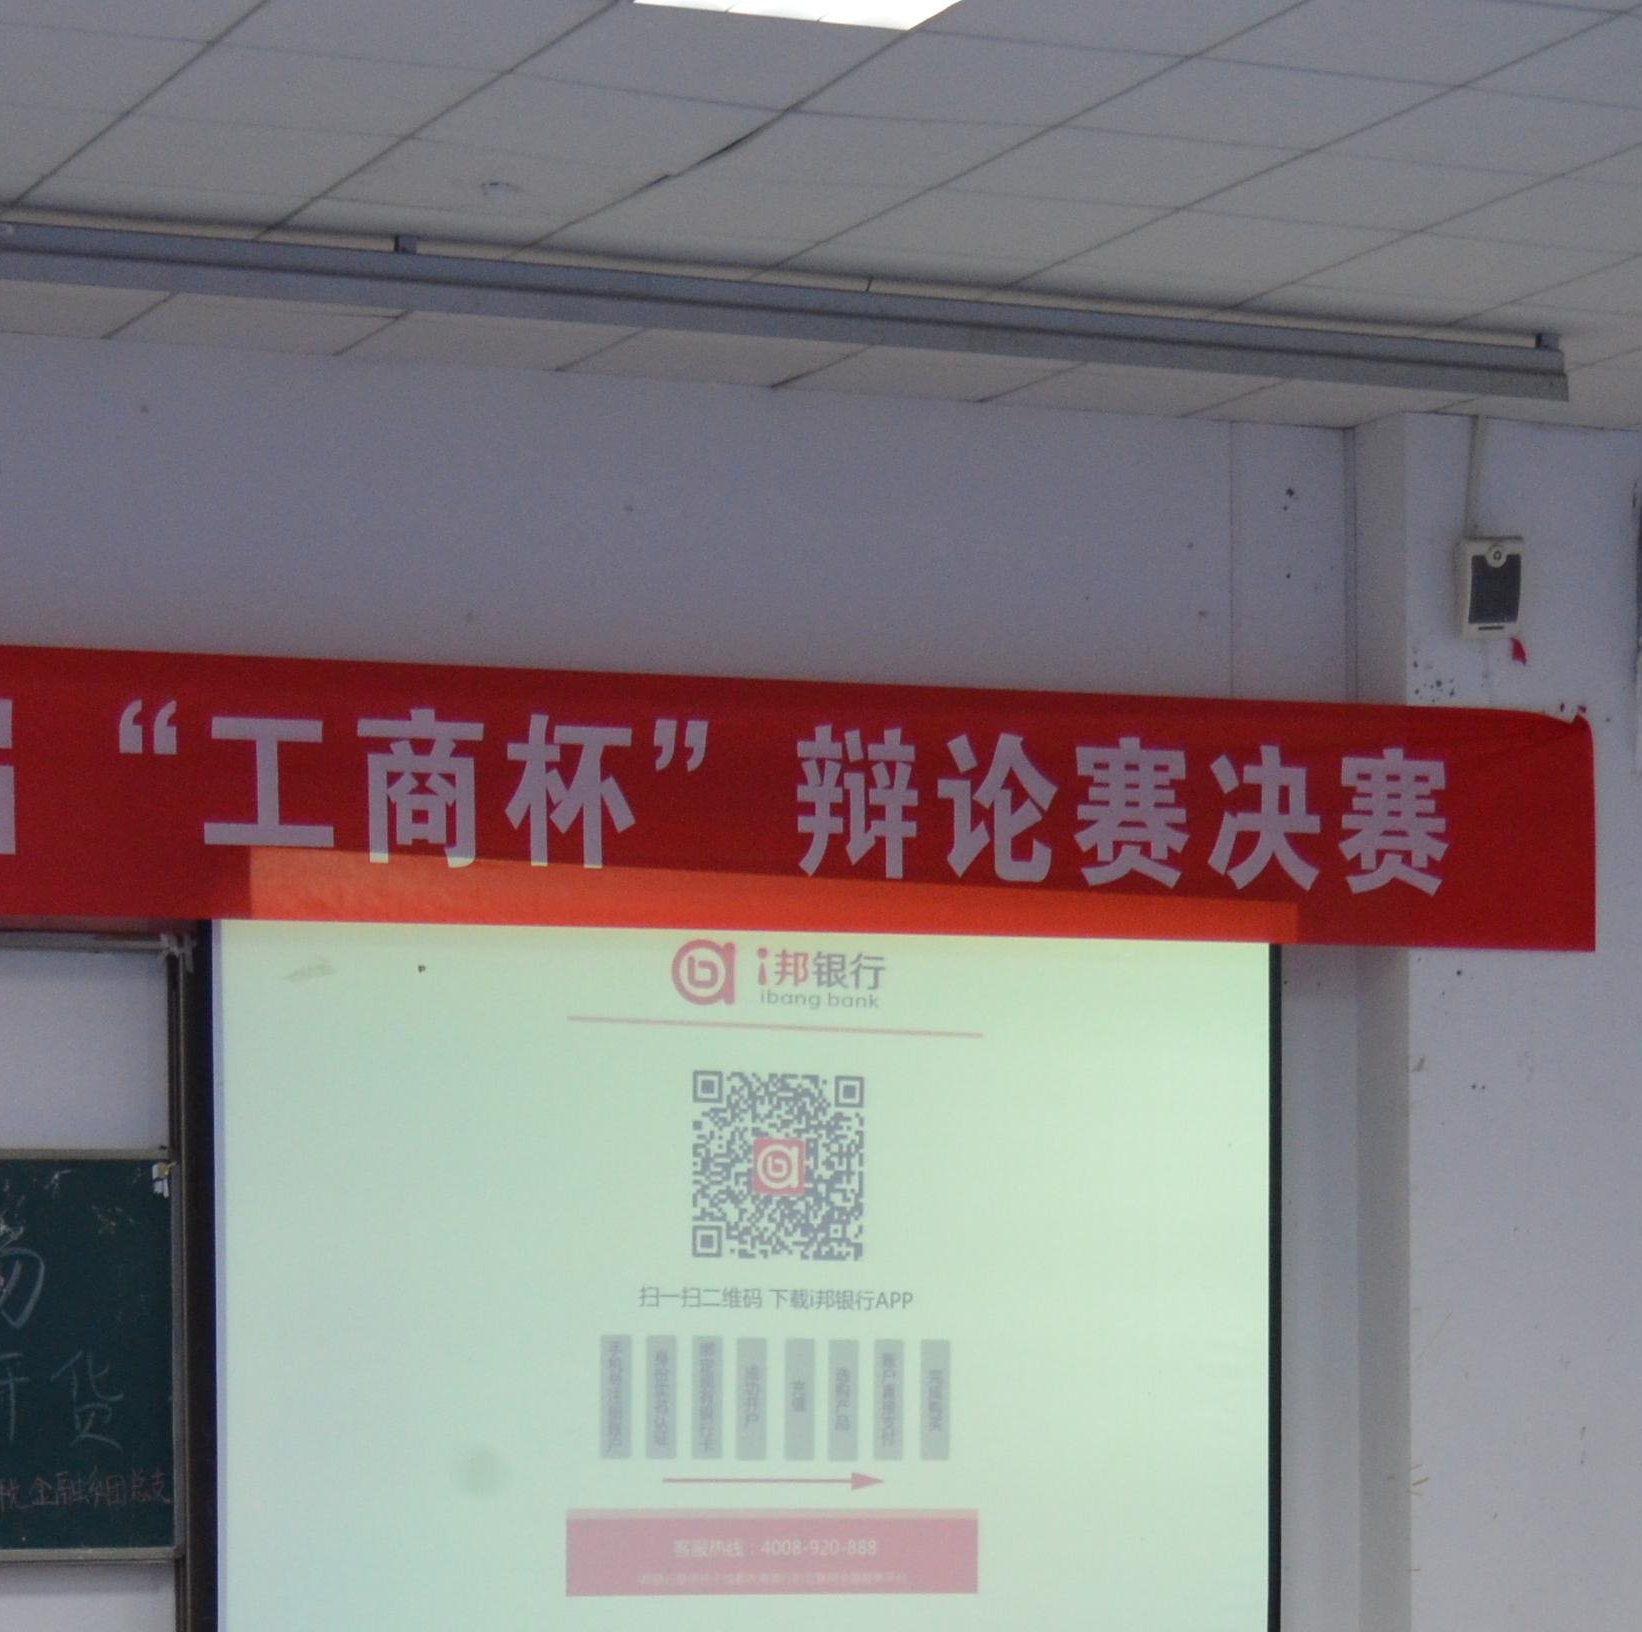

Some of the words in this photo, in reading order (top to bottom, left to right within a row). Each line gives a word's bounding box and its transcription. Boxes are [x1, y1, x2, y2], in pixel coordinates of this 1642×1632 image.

[795, 722, 1450, 896] 辩论赛决赛
[757, 947, 886, 991] i邦银行
[760, 991, 822, 1010] ibang
[828, 992, 880, 1009] bank
[638, 1286, 763, 1309] 扫一扫二维码
